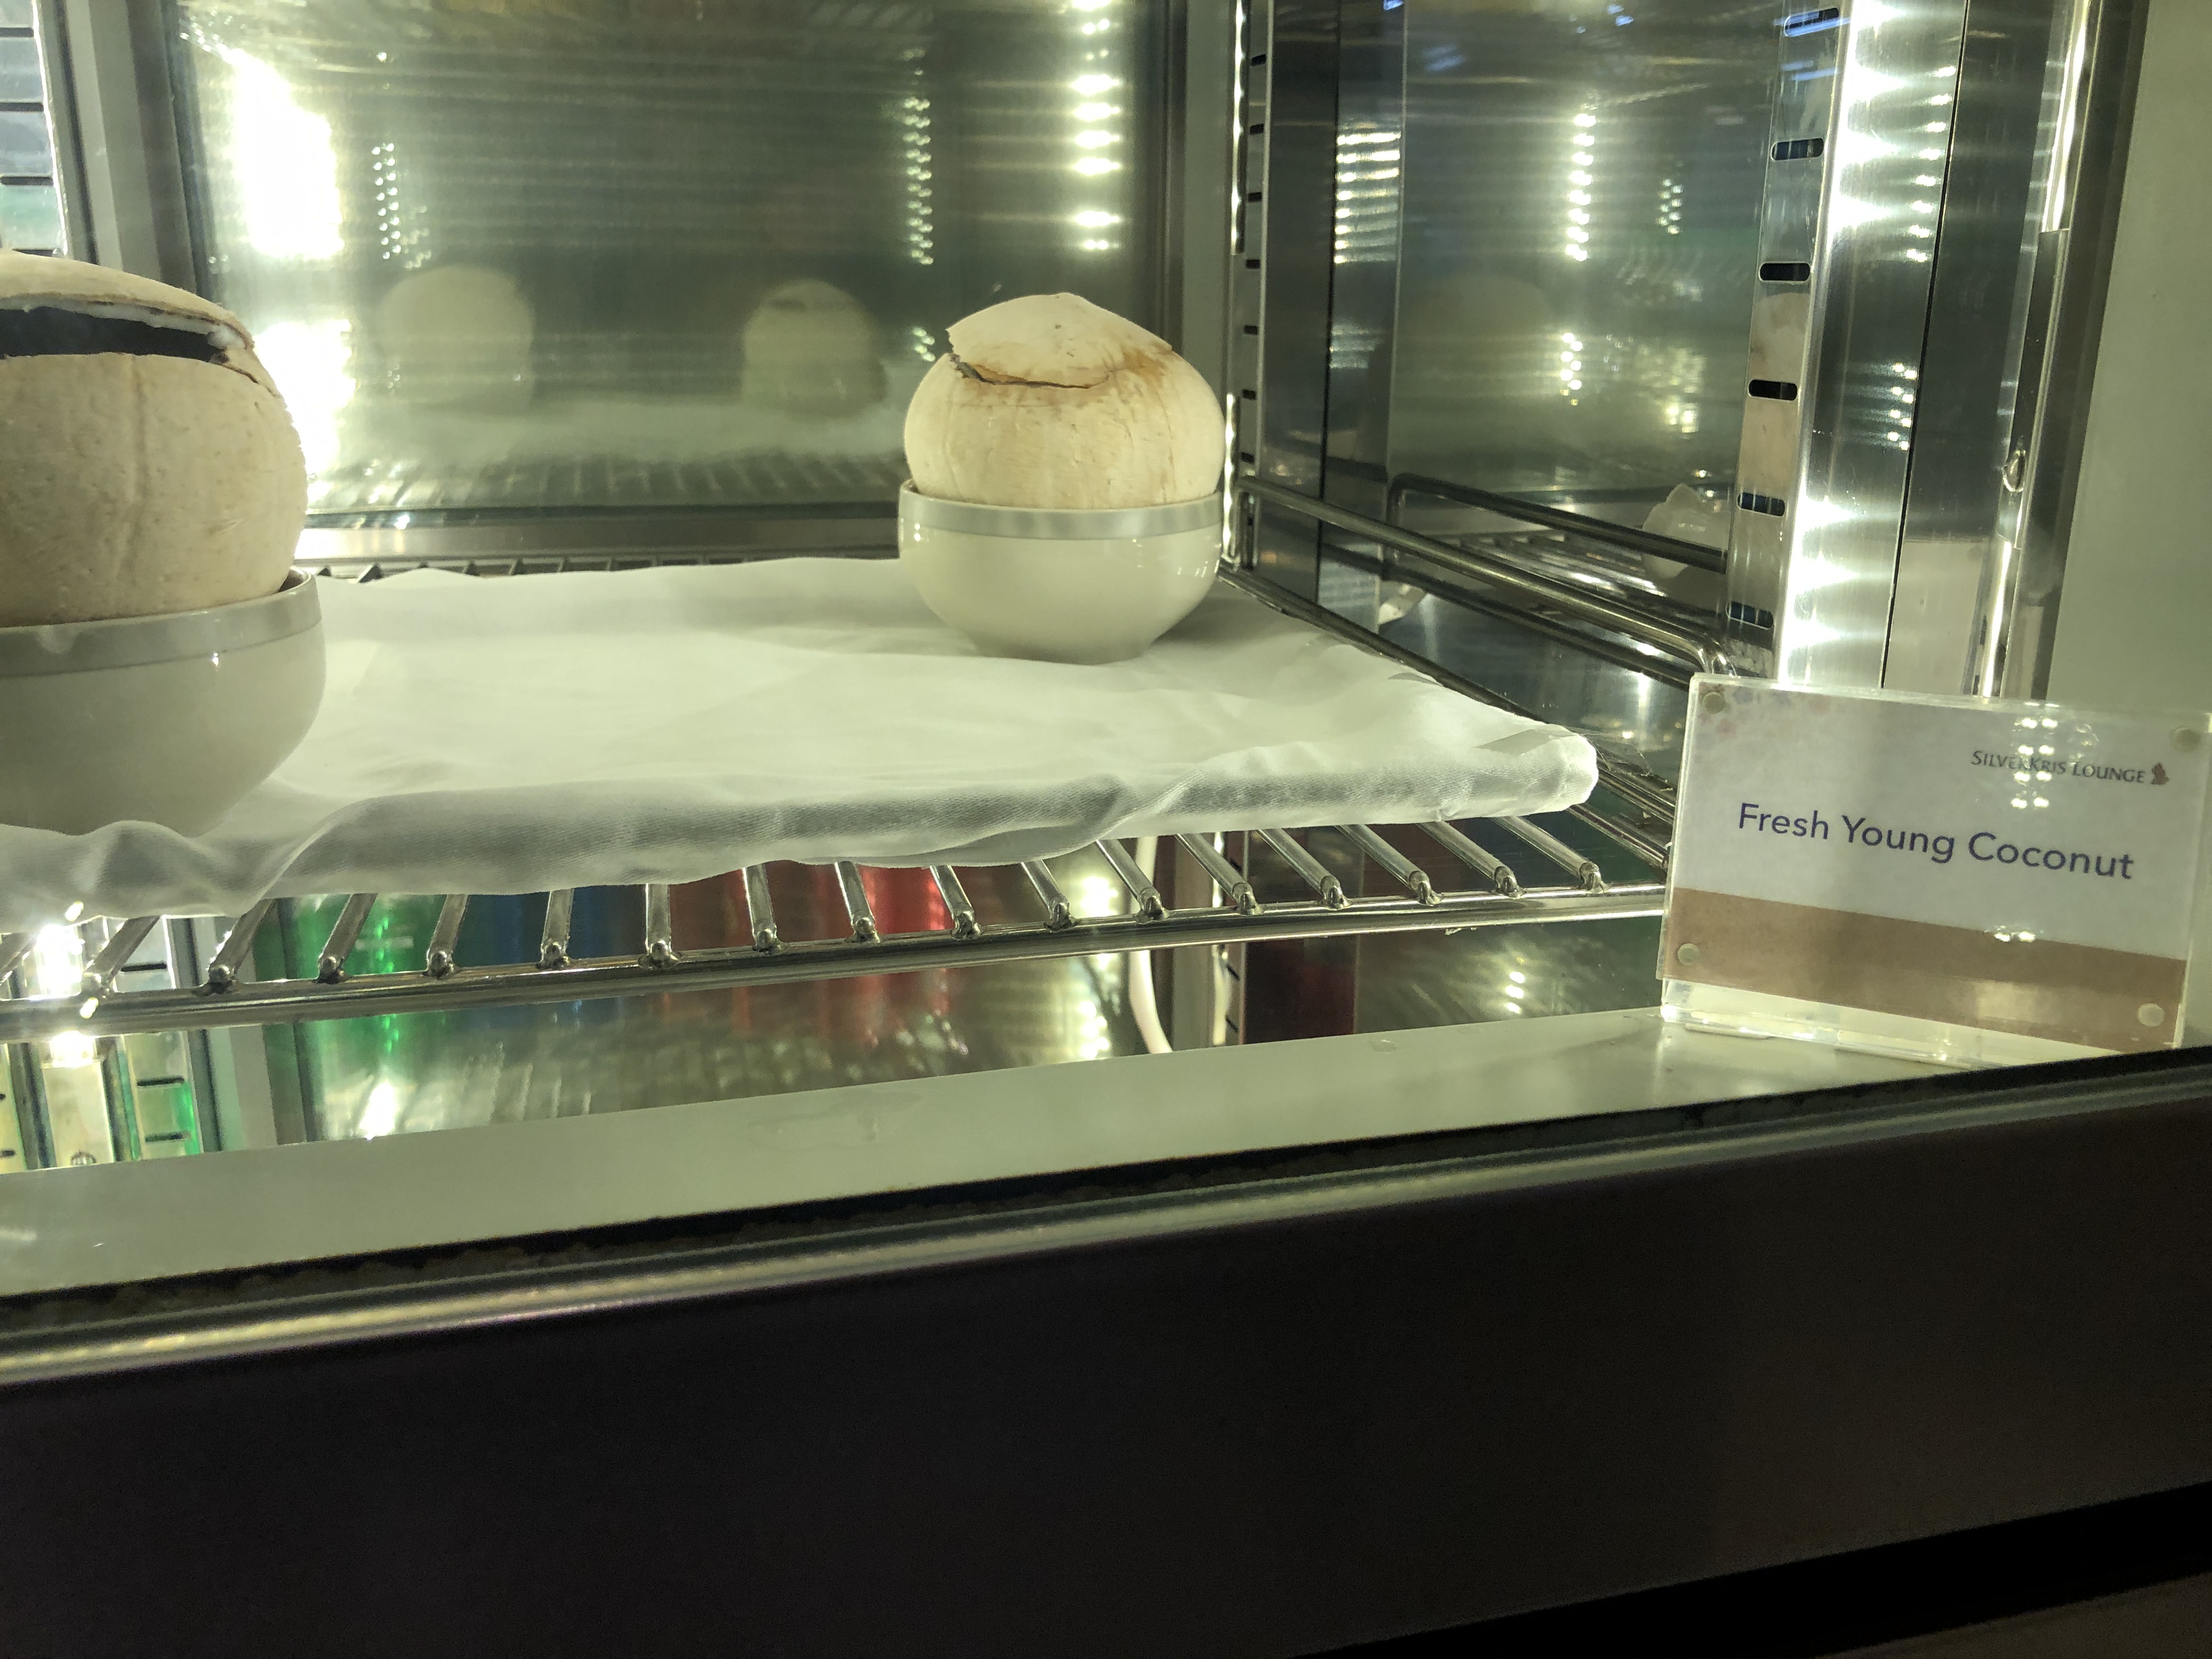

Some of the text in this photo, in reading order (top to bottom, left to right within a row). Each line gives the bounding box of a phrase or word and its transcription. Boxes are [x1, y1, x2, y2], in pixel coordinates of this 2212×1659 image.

[2072, 761, 2146, 783] LOUNGE
[1739, 802, 2135, 879] Fresh Young Coconut
